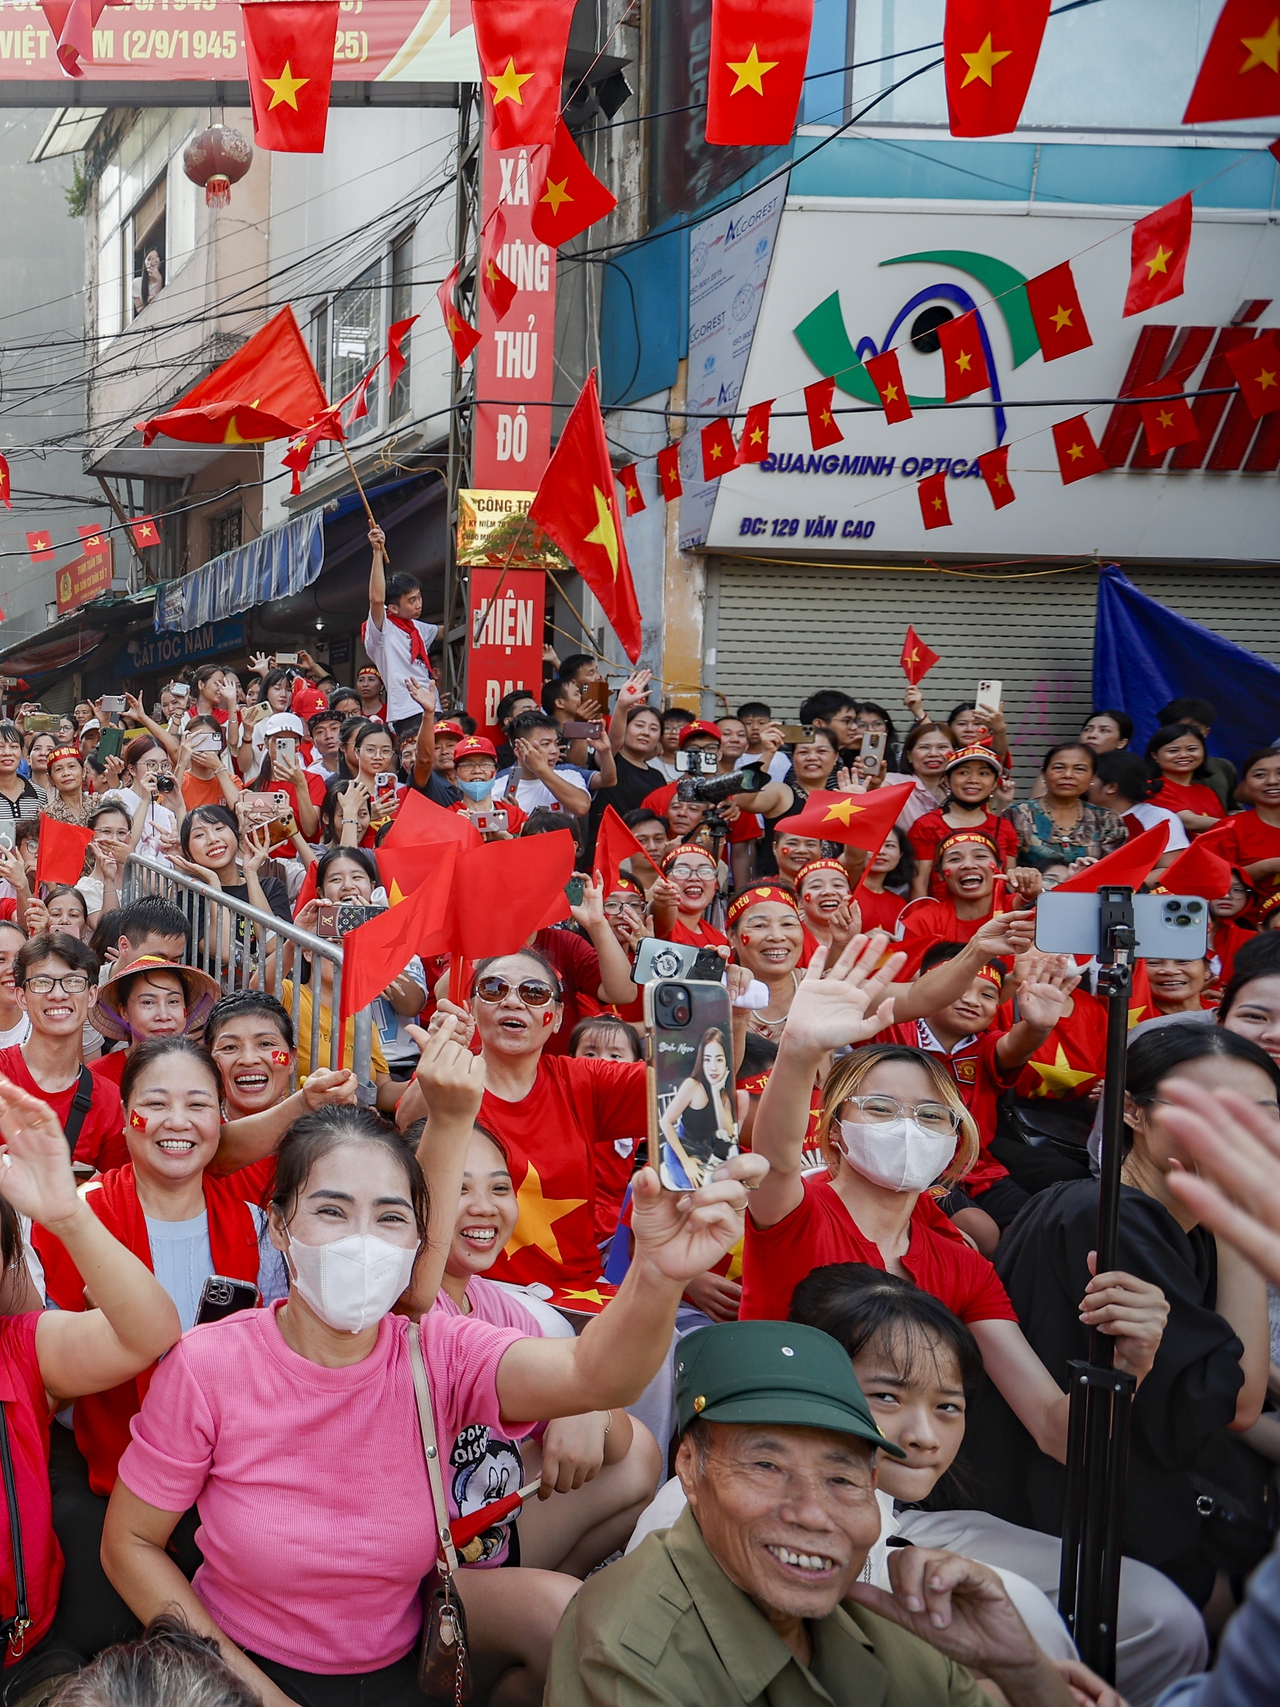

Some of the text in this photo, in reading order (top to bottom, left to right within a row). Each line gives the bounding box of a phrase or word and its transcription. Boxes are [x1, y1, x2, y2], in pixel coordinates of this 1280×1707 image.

[0, 24, 50, 65] VIỆT
[123, 30, 237, 62] (2/9/1945
[499, 149, 532, 206] XÂ
[494, 313, 538, 380] THỦ
[496, 404, 528, 463] ĐÔ
[759, 452, 984, 479] QUANGMINH OPTICA
[477, 495, 513, 513] CÔNG
[739, 515, 876, 538] ĐC: 129 VĂN CAO
[479, 589, 534, 655] HIỆN
[133, 635, 155, 668] CẮT
[157, 633, 181, 662] TÓC
[185, 624, 214, 655] NAM
